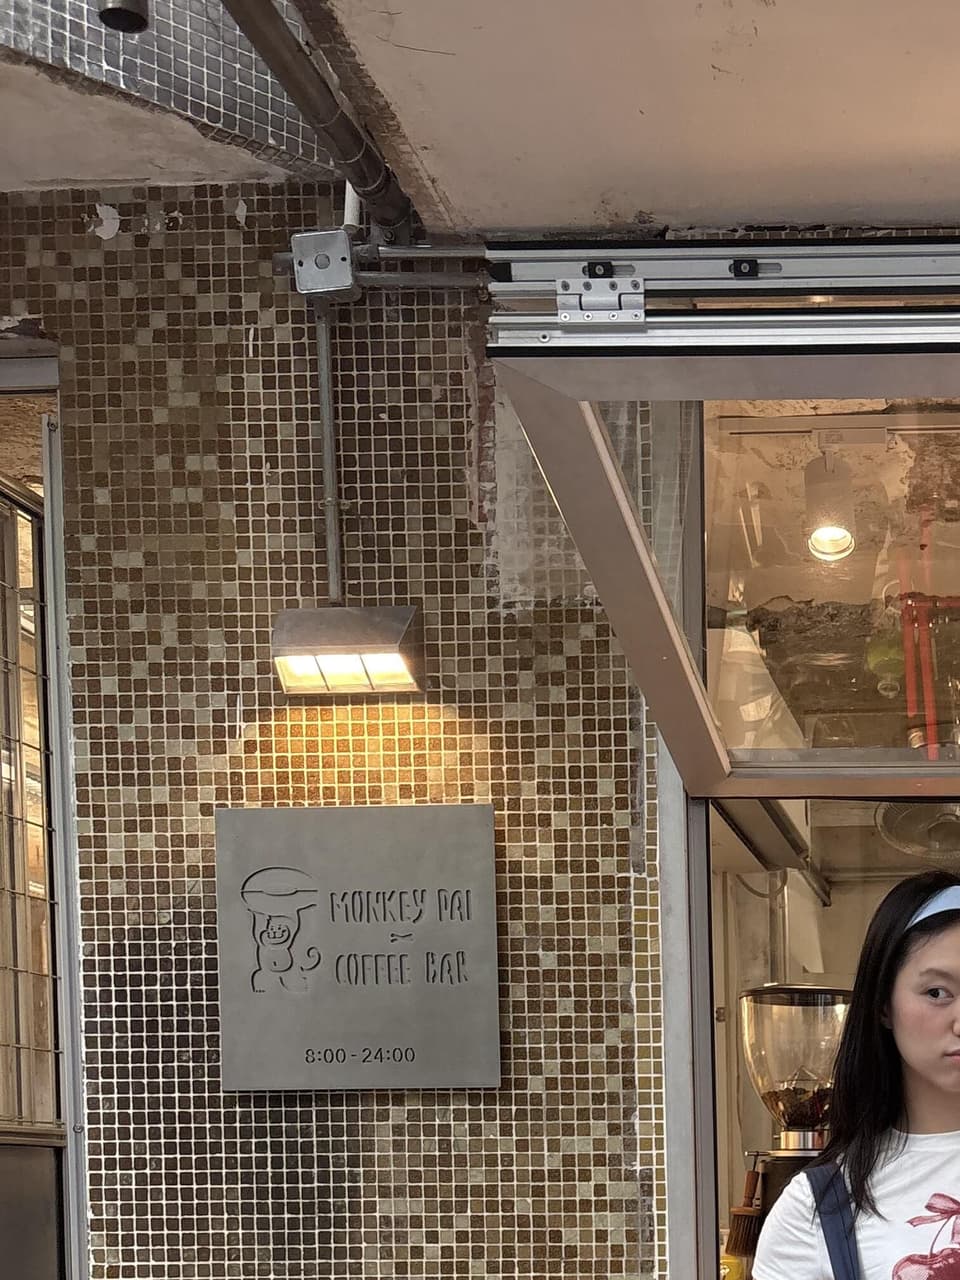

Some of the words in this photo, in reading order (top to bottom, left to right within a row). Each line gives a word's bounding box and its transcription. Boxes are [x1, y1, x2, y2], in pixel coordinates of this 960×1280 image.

[330, 889, 426, 923] MONKEY
[437, 888, 471, 921] PAI
[335, 953, 411, 985] COFFEE
[425, 951, 468, 985] BAR
